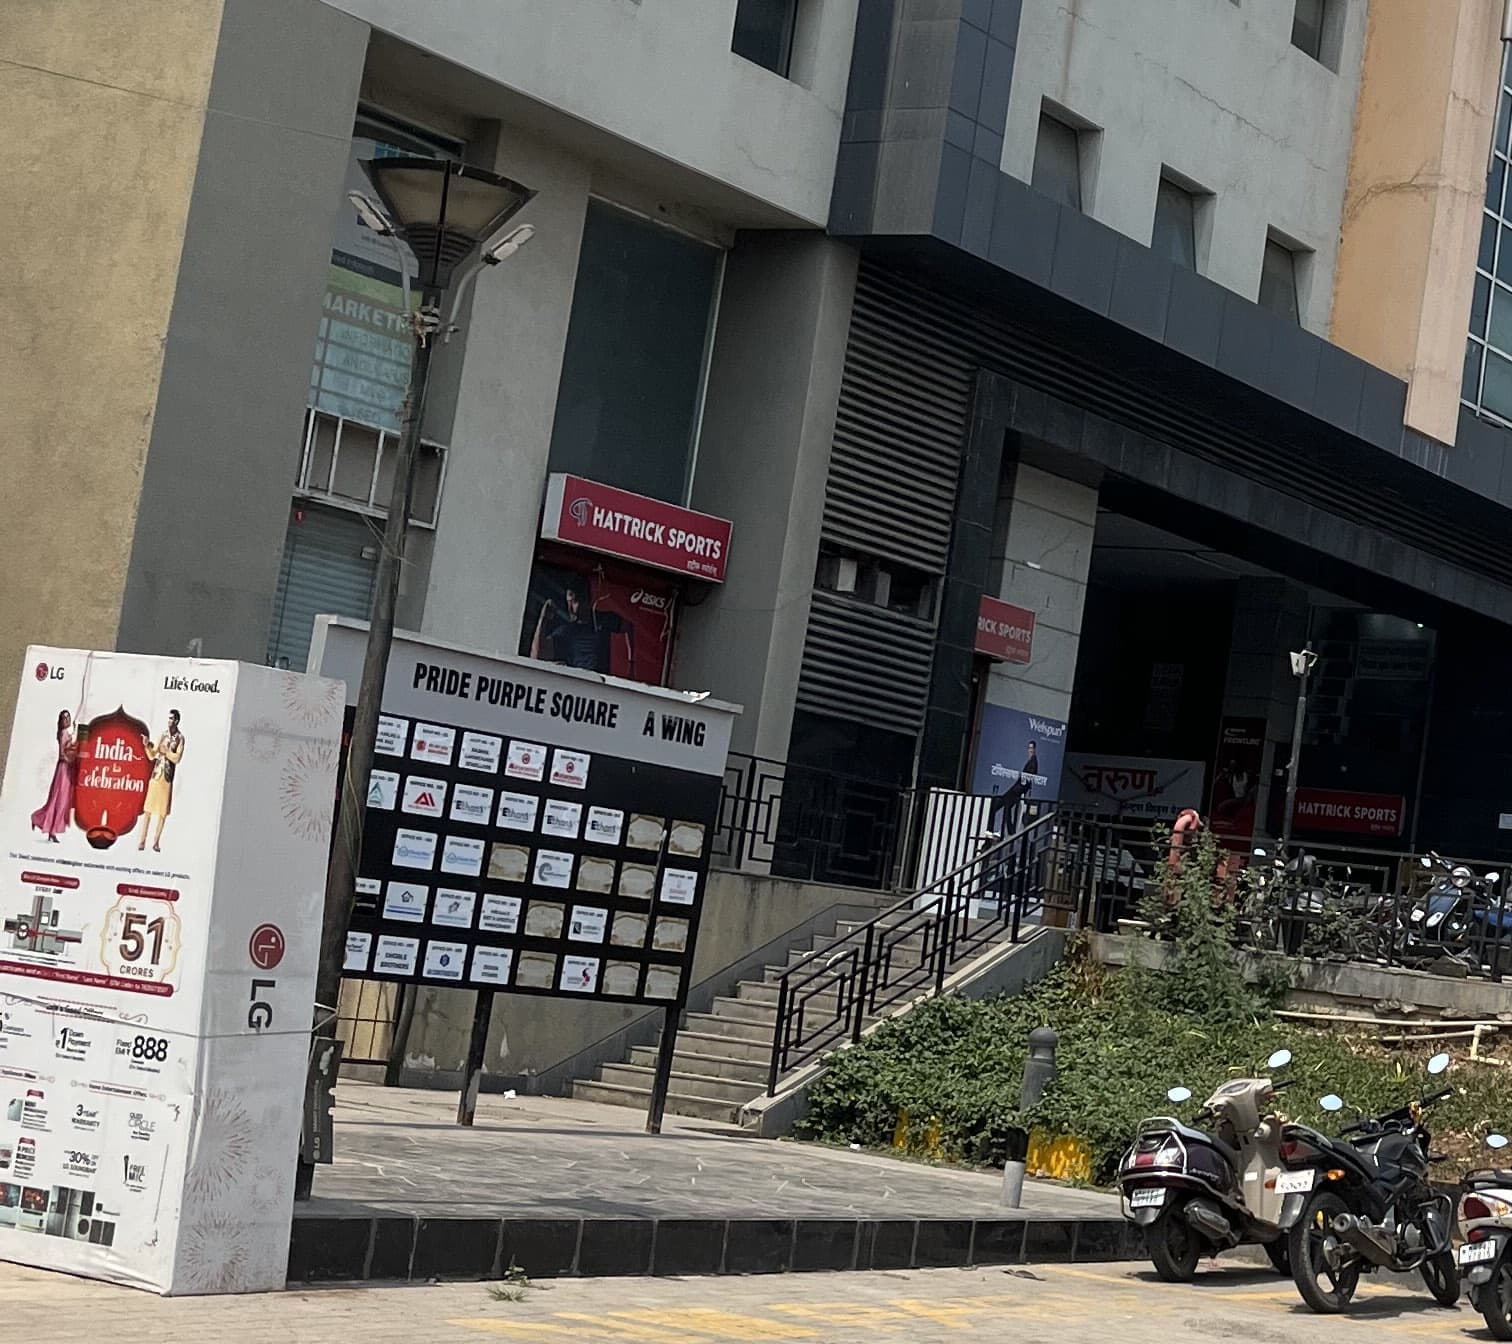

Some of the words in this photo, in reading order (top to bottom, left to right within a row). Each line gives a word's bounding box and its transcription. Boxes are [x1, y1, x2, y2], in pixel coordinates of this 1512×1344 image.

[593, 507, 666, 545] HATTRICK
[667, 527, 722, 560] SPORTS
[998, 623, 1031, 643] SPORTS
[163, 676, 189, 691] Life's
[413, 662, 471, 699] PRIDE
[475, 677, 546, 714] PURPLE
[550, 691, 619, 728] SQUARE
[643, 711, 655, 737] A
[661, 714, 706, 747] WING
[1028, 717, 1063, 737] Welspun
[95, 736, 143, 761] India
[78, 767, 144, 793] Celebration
[1298, 802, 1351, 818] HATTRICK
[1354, 806, 1397, 822] SPORTS
[119, 965, 154, 978] CRORES
[248, 979, 276, 1030] LG
